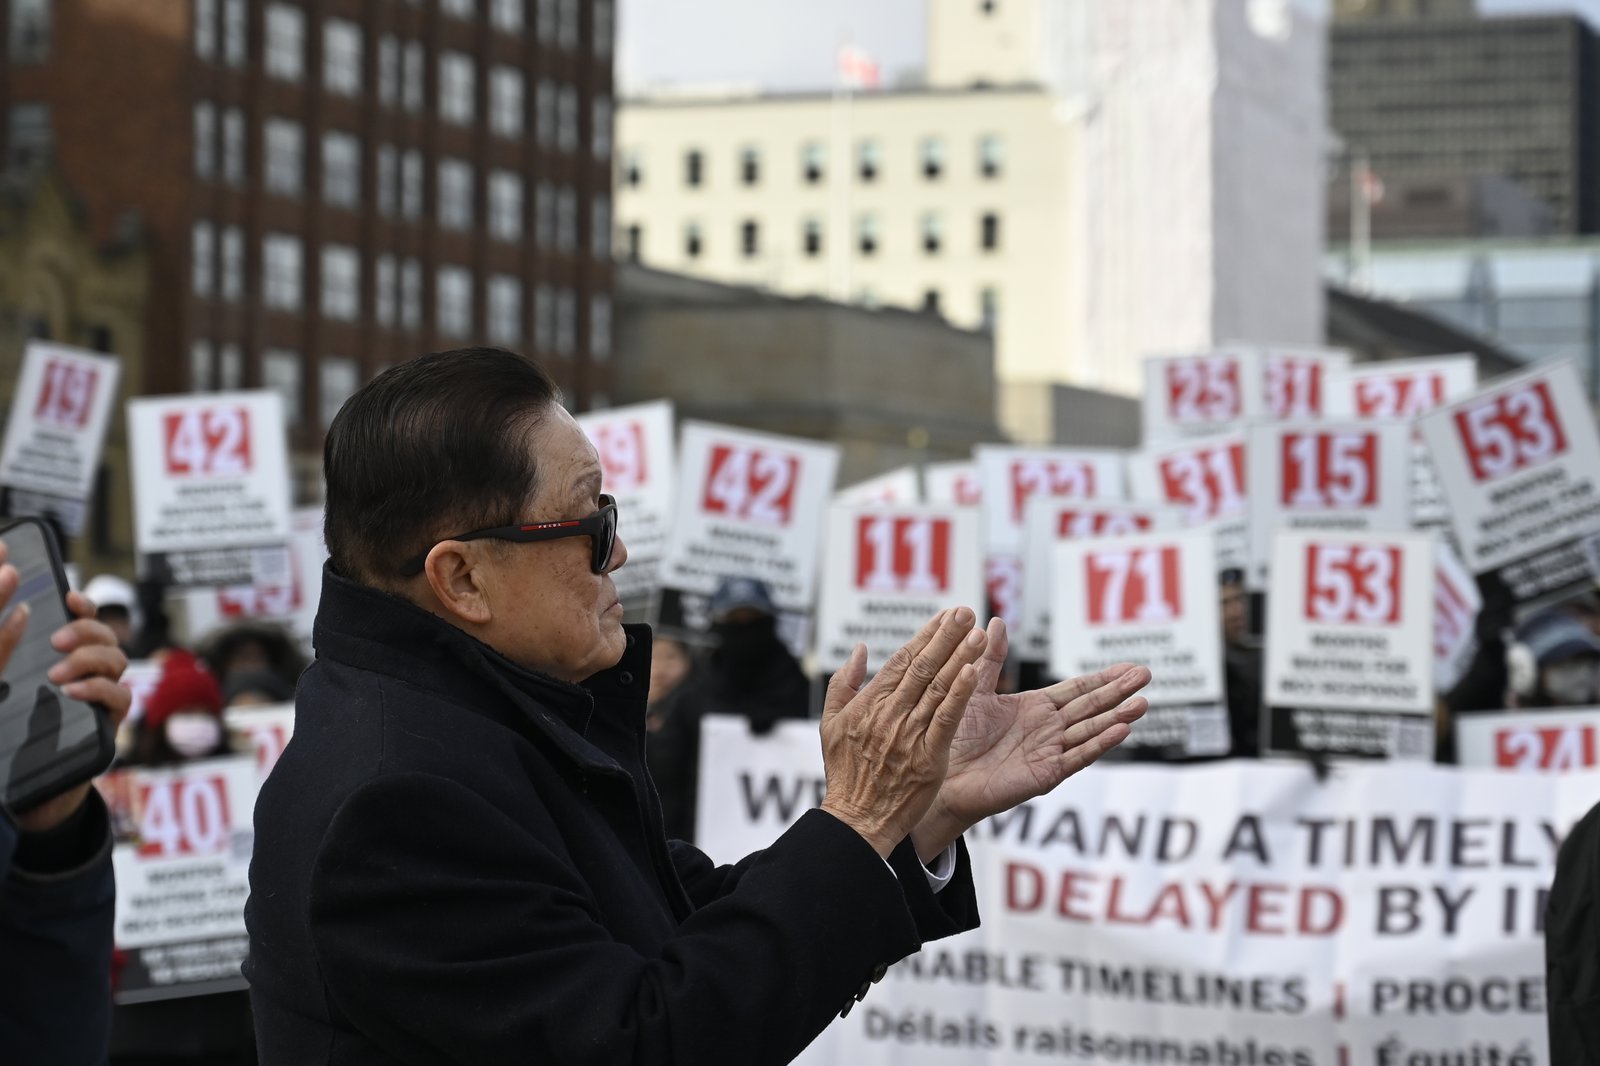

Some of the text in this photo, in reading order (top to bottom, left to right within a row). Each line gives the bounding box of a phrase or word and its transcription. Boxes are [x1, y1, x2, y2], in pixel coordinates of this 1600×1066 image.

[166, 408, 252, 474] 42
[1290, 434, 1370, 506] 15
[1467, 391, 1557, 476] 53
[708, 446, 794, 523] 42
[1168, 448, 1246, 523] 31
[865, 517, 942, 591] 11
[1092, 549, 1177, 624] 71
[1311, 547, 1394, 622] 53
[141, 778, 226, 857] 40
[1223, 814, 1270, 865] A
[1005, 861, 1549, 936] DELAYED BY I
[1056, 957, 1307, 1014] TIMELINES
[863, 1006, 1001, 1048] Délais
[1013, 1020, 1317, 1066] raisonnables
